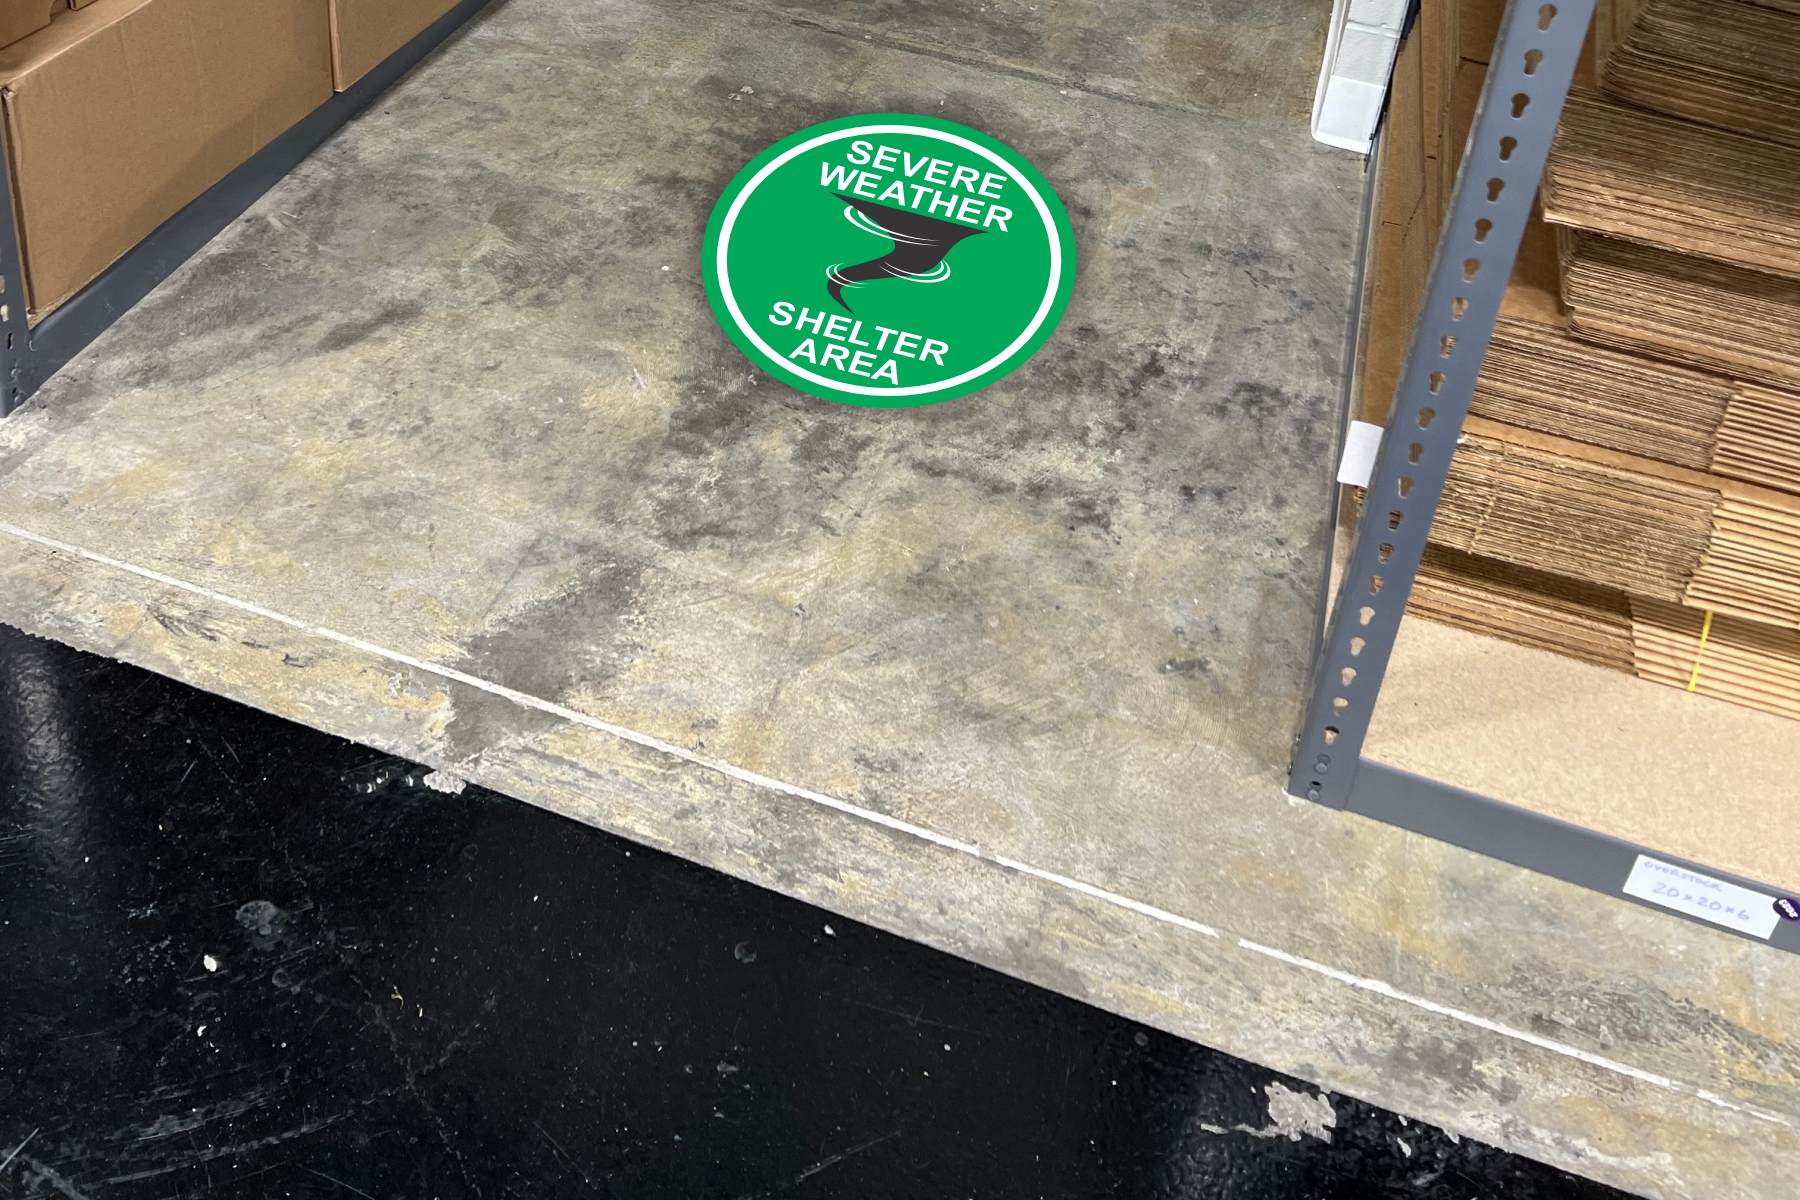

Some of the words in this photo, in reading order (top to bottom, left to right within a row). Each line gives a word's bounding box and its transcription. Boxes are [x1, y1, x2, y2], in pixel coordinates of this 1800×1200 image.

[820, 161, 1013, 232] WEATHER
[846, 140, 1008, 200] SEVERE
[768, 301, 949, 366] SHELTER
[789, 338, 900, 386] AREA
